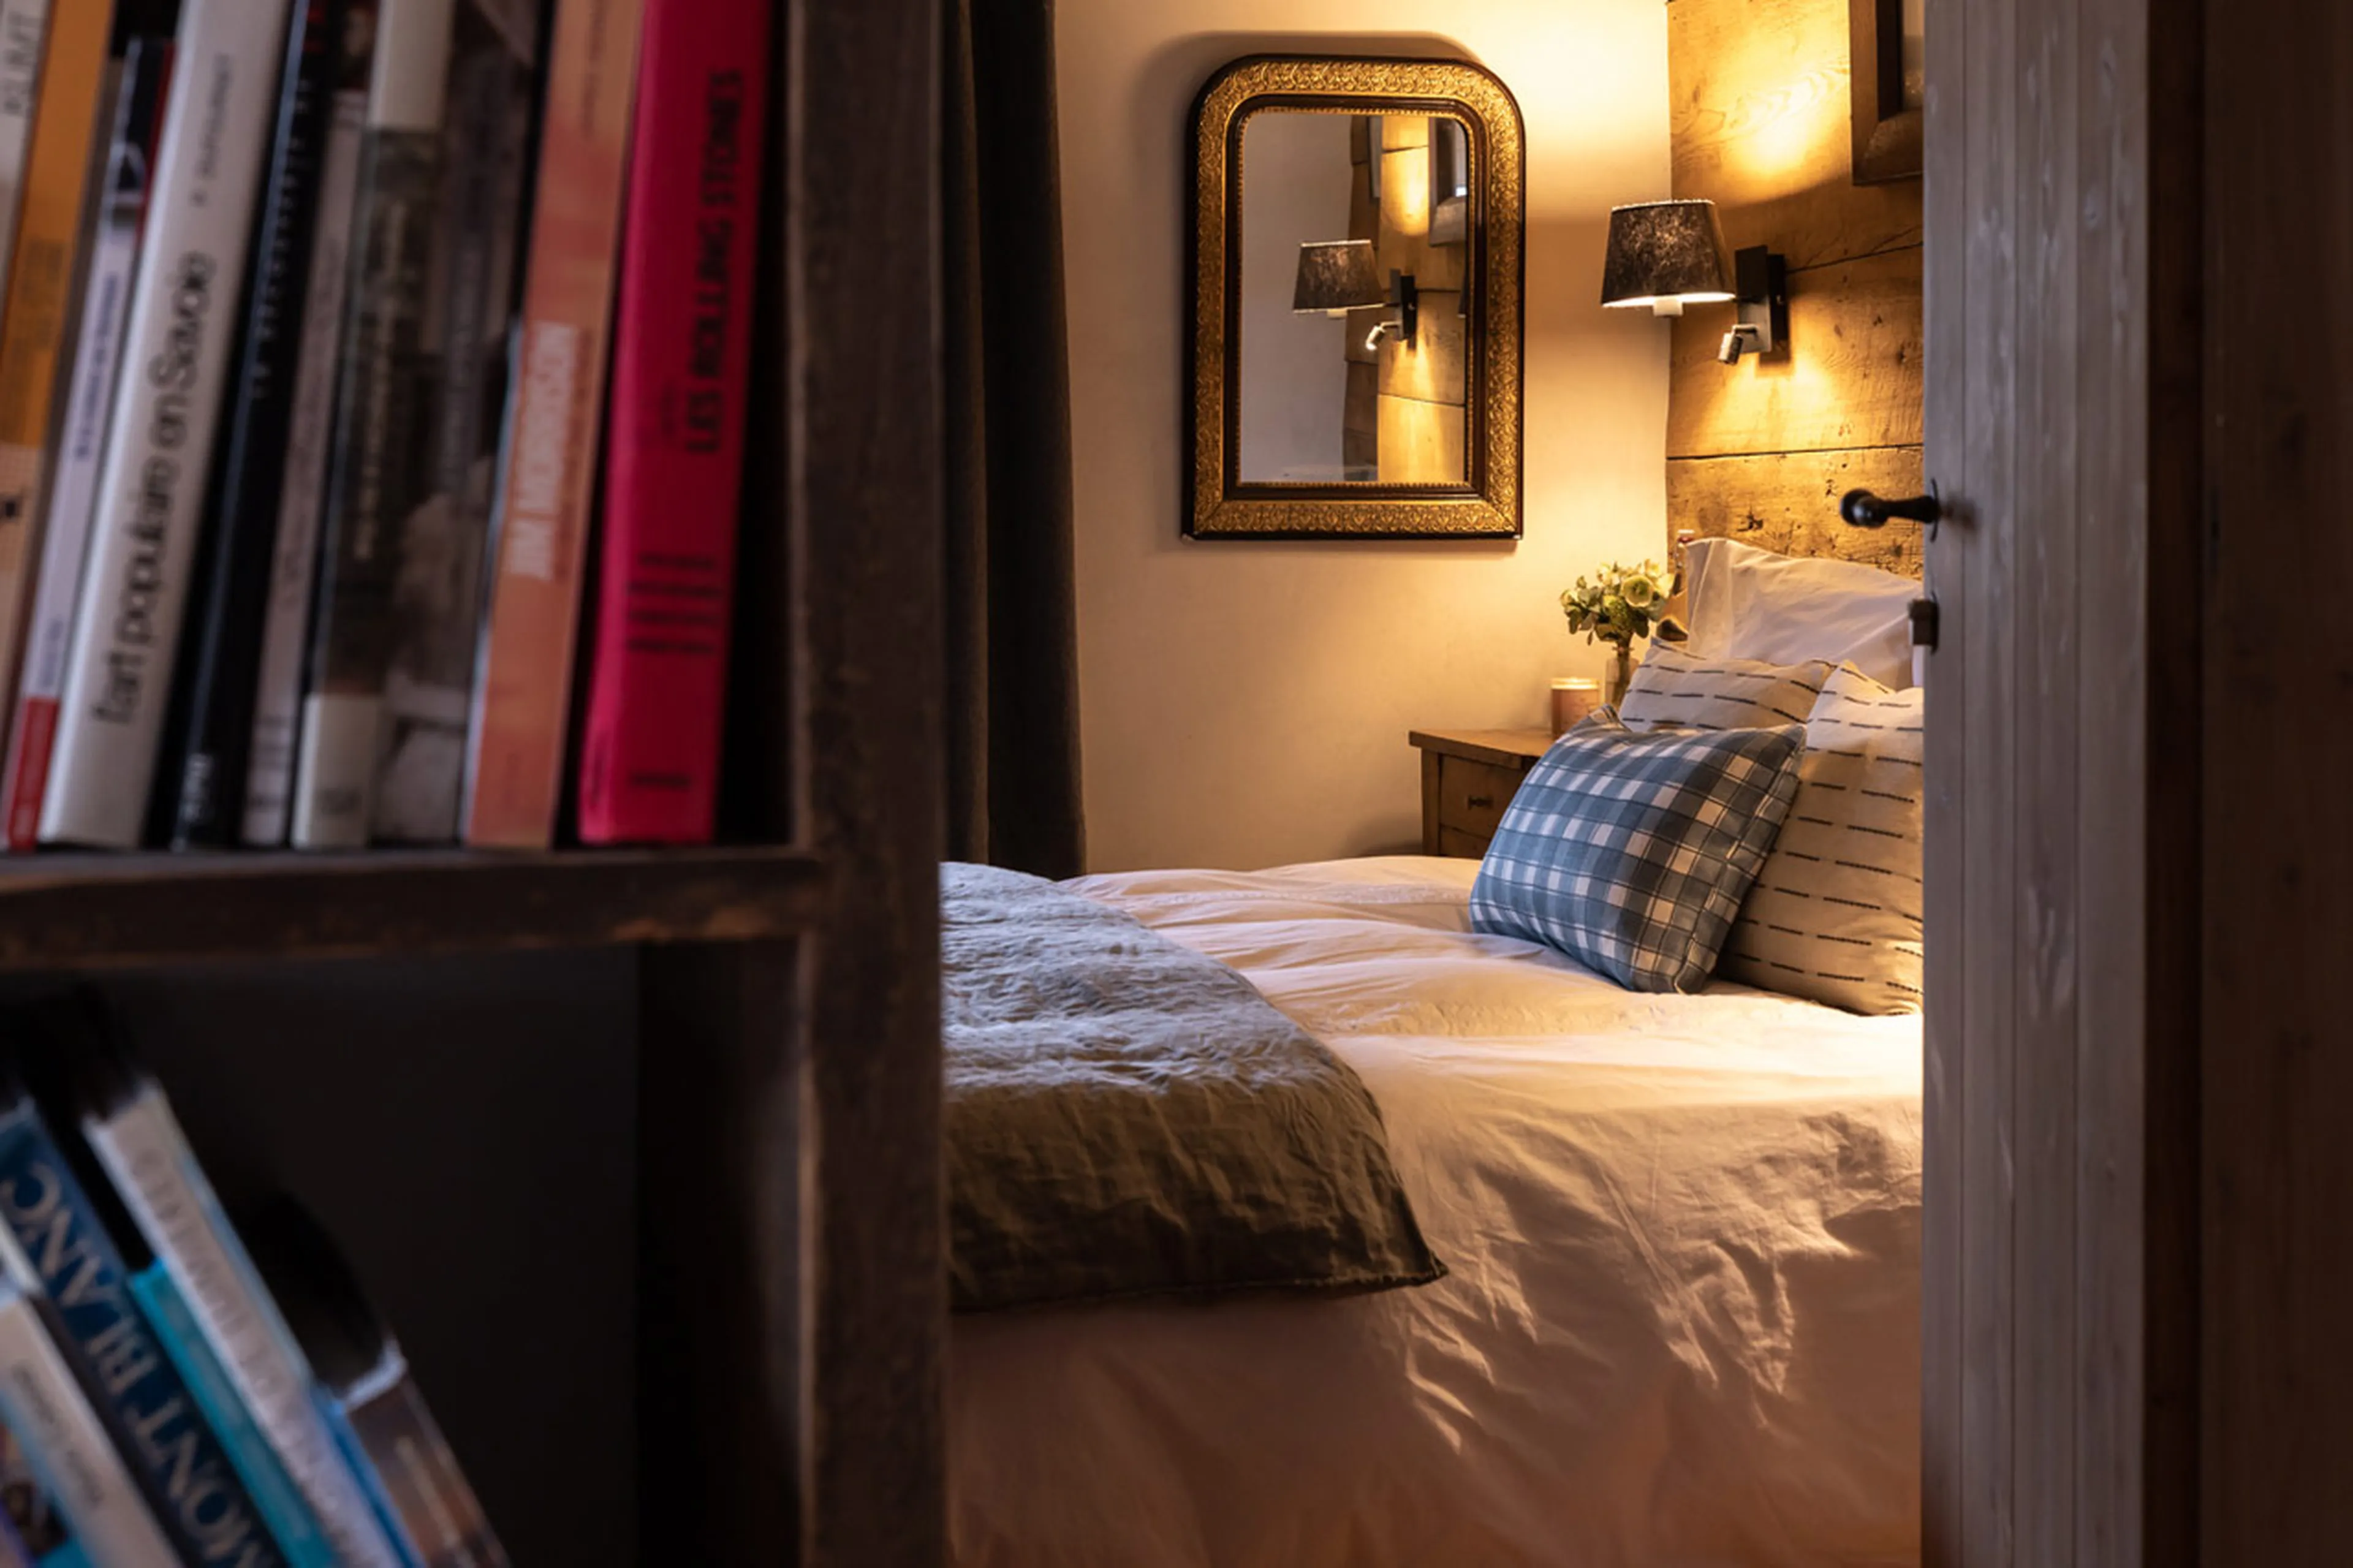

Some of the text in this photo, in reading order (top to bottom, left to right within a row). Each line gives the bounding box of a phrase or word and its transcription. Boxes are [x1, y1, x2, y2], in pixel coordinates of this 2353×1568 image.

[147, 251, 217, 391] Savoie
[684, 69, 744, 455] LES ROLLING STONES
[148, 394, 193, 450] en
[113, 455, 183, 646] populaire
[1, 1160, 159, 1398] BLANC
